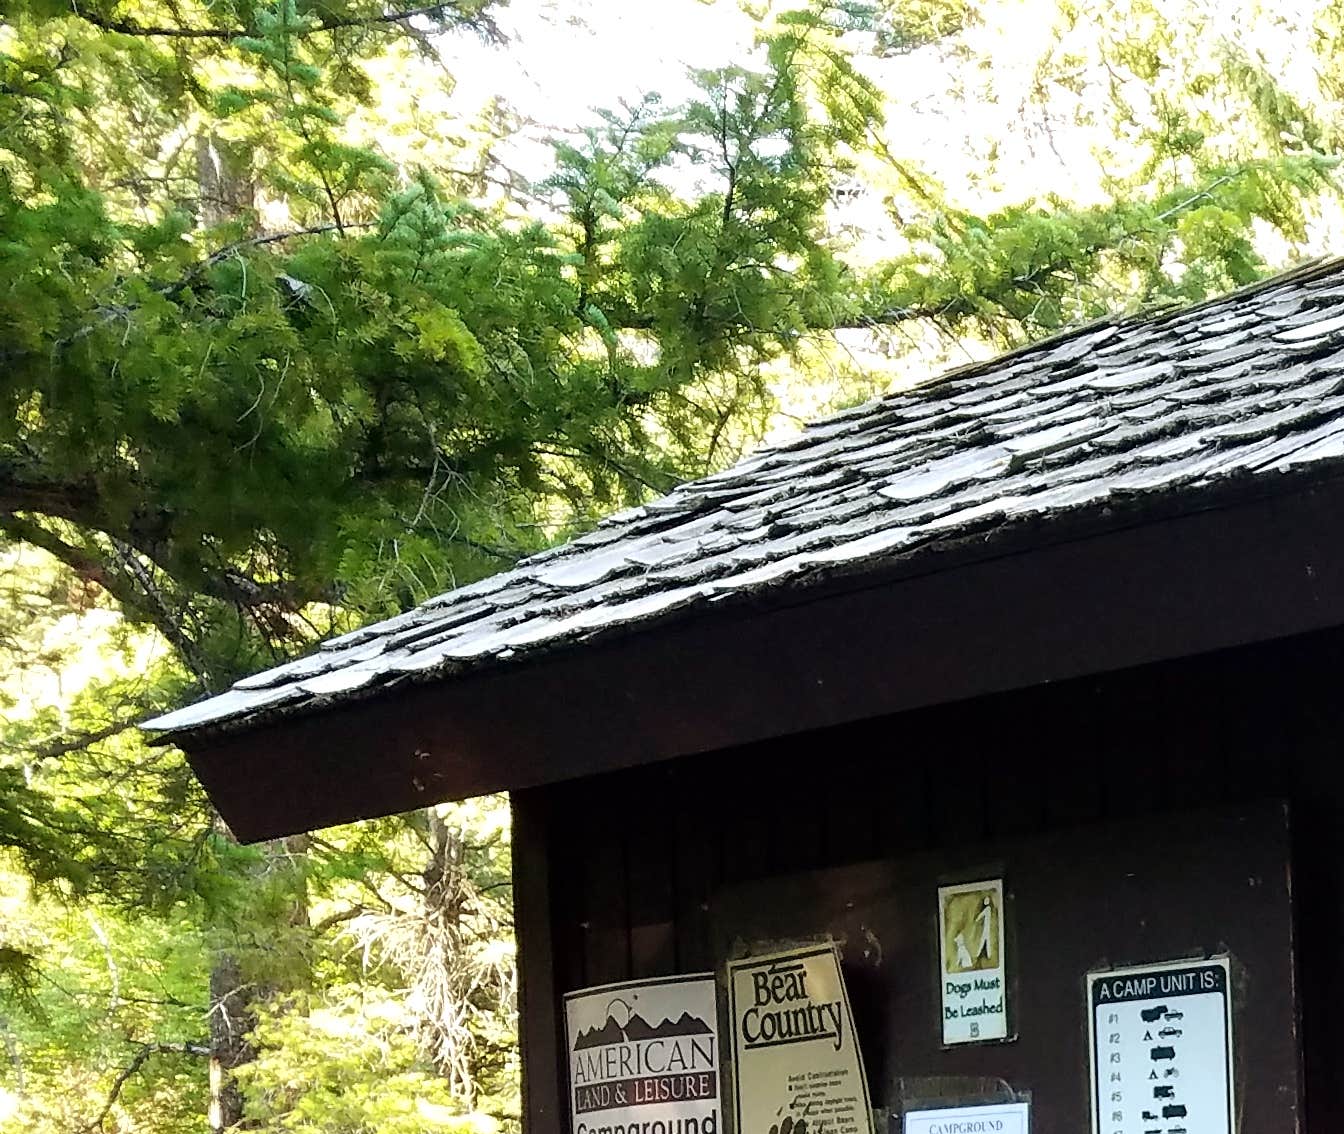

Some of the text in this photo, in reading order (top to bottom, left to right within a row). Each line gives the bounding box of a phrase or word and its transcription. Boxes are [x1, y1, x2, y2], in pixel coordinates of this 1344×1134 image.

[752, 970, 809, 1006] Bear
[946, 978, 1000, 998] Dogs Must
[1100, 971, 1219, 999] A CAMP UNIT IS:
[945, 996, 1002, 1019] Be Leashed
[742, 1001, 842, 1051] Country
[1108, 1014, 1118, 1024] #1
[1109, 1034, 1120, 1044] #2
[574, 1037, 714, 1083] AMERICAN
[1110, 1053, 1121, 1063] #3
[1111, 1073, 1121, 1082] #4
[577, 1075, 710, 1110] LAND & LEISURE
[1111, 1092, 1122, 1102] #5
